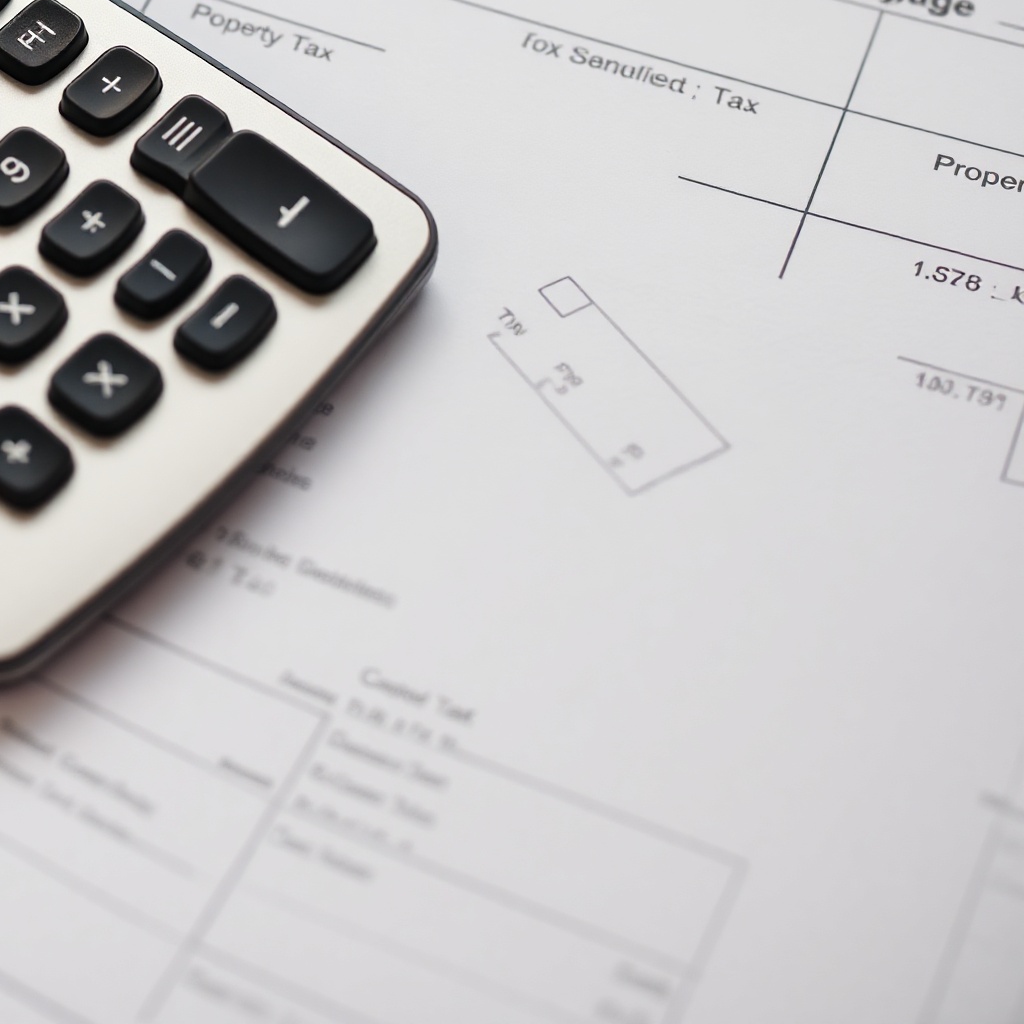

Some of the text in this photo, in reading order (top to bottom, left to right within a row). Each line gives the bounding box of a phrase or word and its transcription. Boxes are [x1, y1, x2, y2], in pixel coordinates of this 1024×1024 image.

[189, 2, 336, 63] Poperty Tax
[713, 85, 761, 115] Tax
[0, 155, 31, 184] 9
